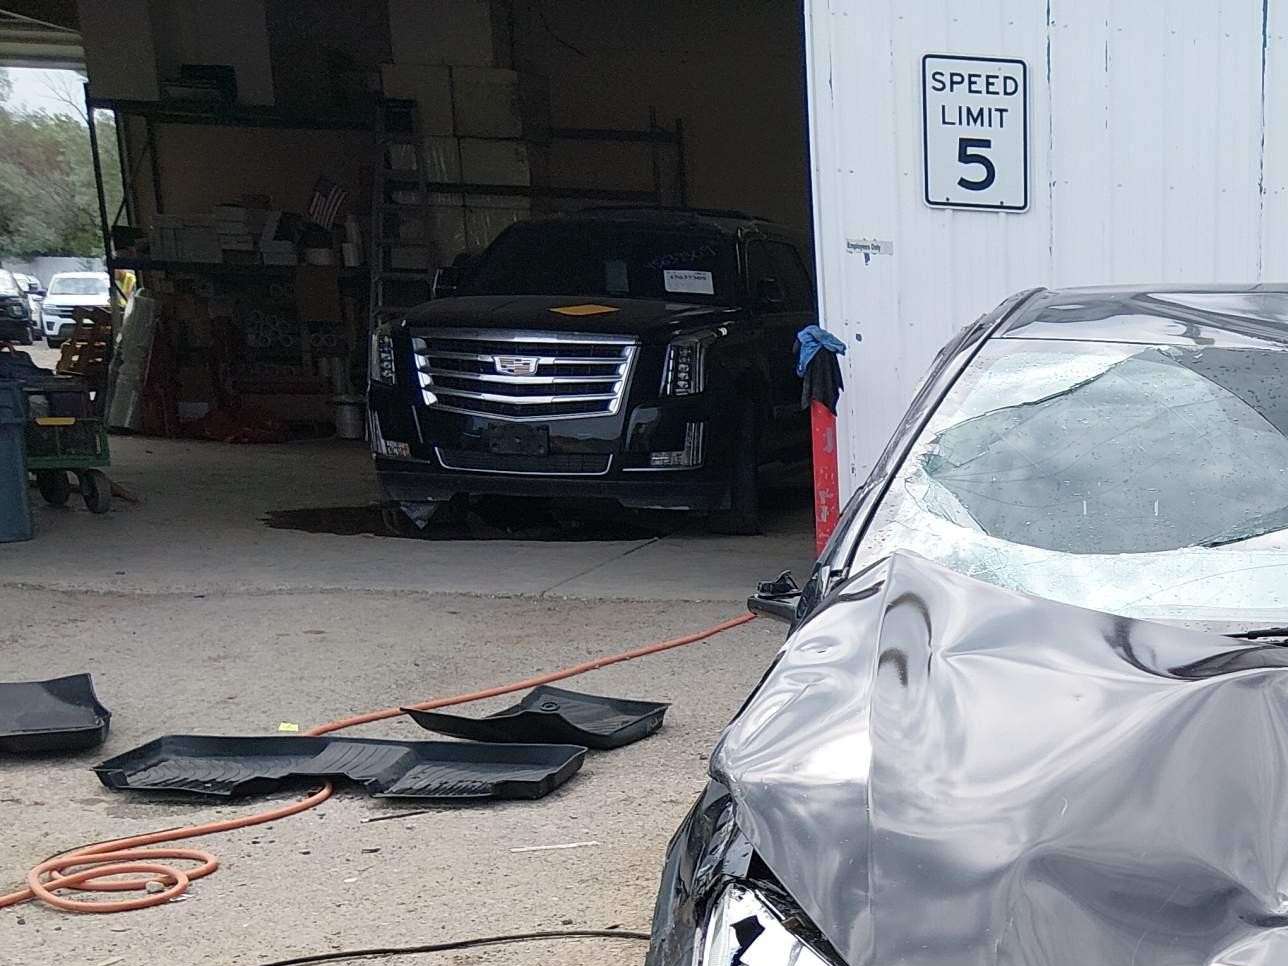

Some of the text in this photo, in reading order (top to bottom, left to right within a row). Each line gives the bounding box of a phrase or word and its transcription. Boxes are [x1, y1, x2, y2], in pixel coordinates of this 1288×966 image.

[931, 71, 1019, 96] SPEED
[941, 104, 1009, 128] LIMIT
[957, 137, 996, 191] 5
